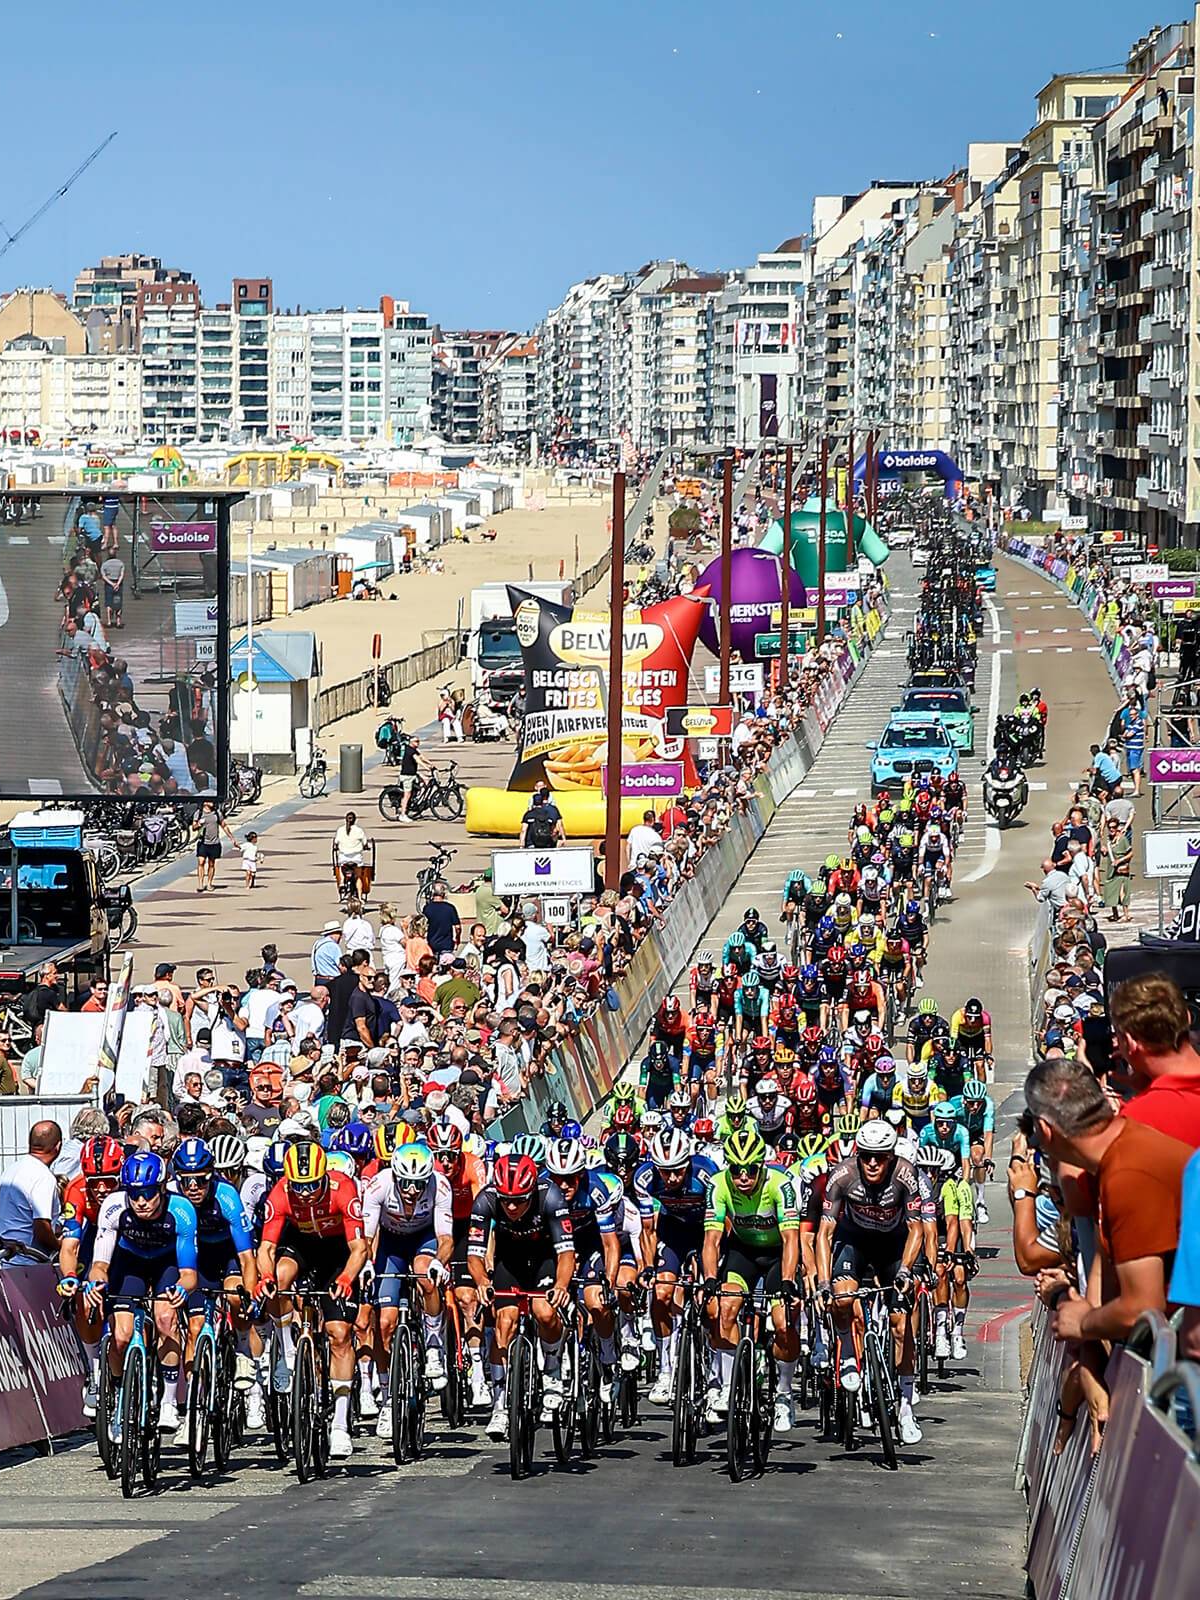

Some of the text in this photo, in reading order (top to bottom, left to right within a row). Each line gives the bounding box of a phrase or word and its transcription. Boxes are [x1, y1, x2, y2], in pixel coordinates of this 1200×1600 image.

[895, 454, 937, 467] baloise
[169, 532, 209, 543] baloise
[561, 629, 648, 651] BELVVA
[199, 646, 212, 656] 100
[544, 688, 662, 707] FRITES LGES
[526, 714, 549, 732] OVEN
[621, 718, 649, 729] ITEUSE
[525, 728, 550, 747] FOUR
[625, 774, 675, 787] baloise
[548, 906, 565, 916] 100
